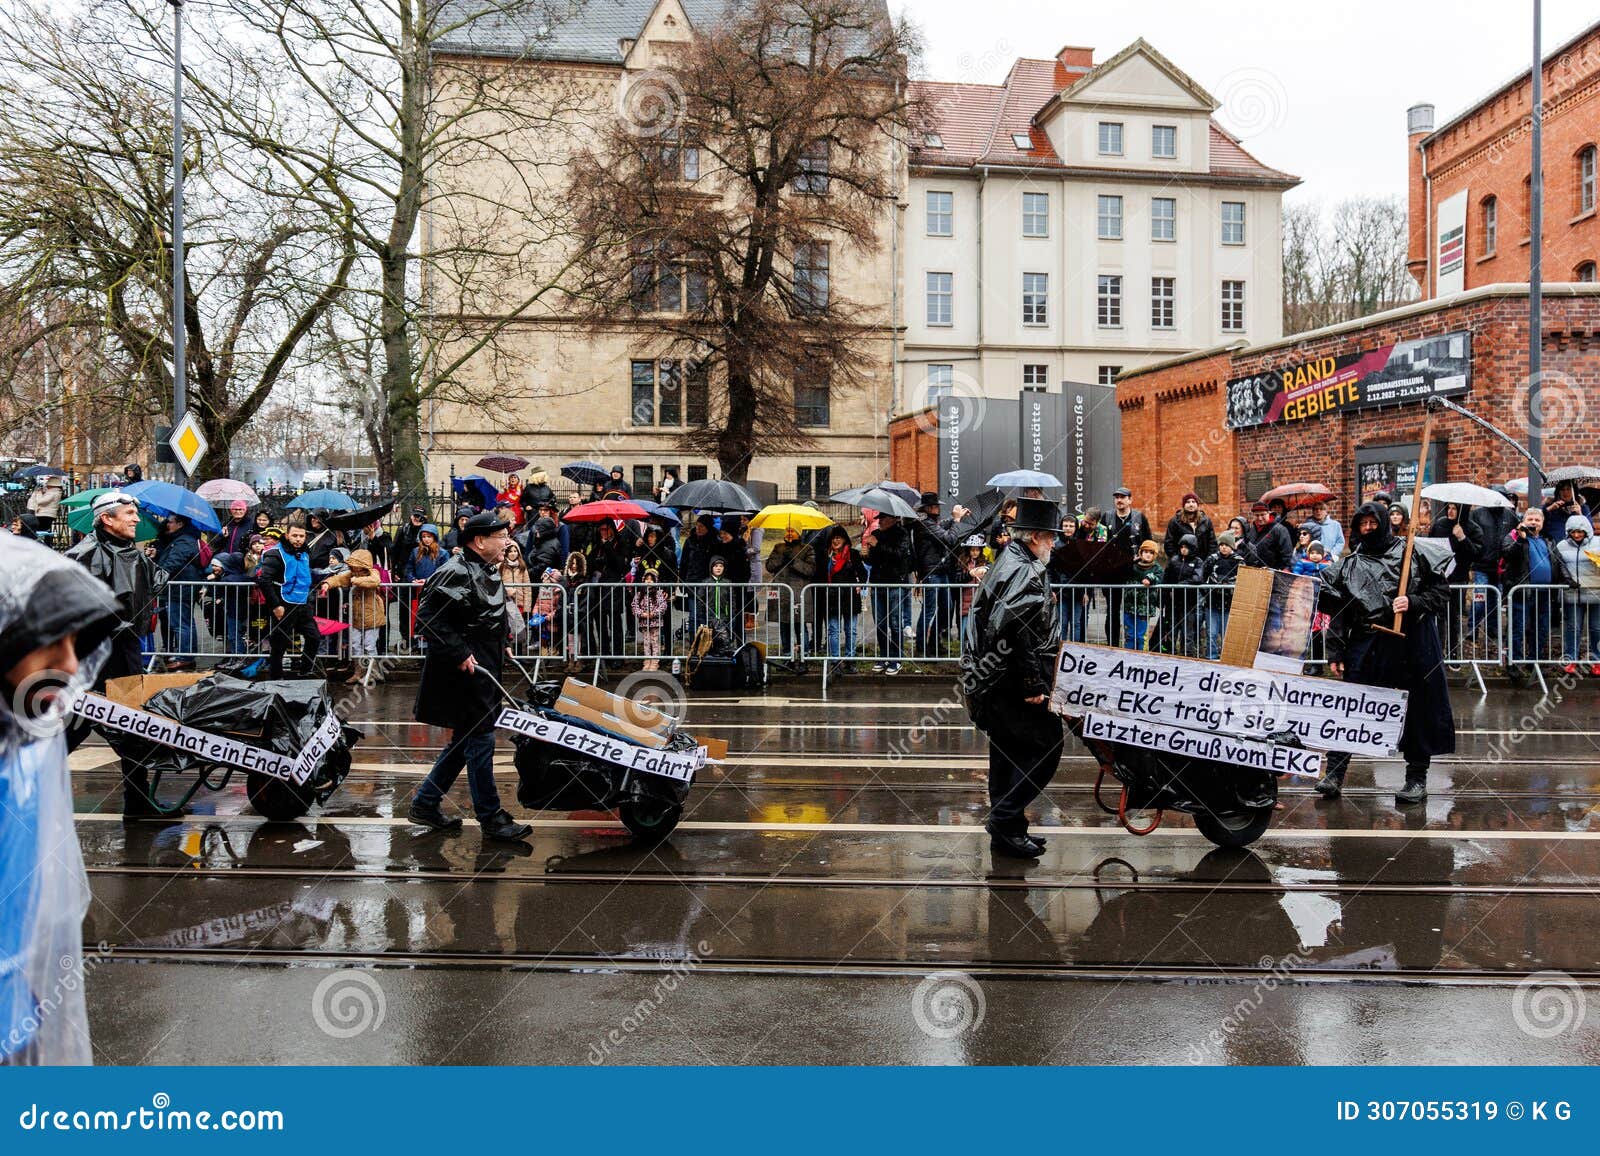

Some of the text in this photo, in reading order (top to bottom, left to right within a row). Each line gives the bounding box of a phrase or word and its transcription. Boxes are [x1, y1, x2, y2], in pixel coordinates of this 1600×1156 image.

[1283, 356, 1336, 394] RAND
[1284, 377, 1360, 420] GEBIETE
[1366, 376, 1424, 392] SONDERAUSSTELLUNG
[1400, 385, 1432, 397] 21.4.2024
[948, 405, 960, 497] Gedenkstätte
[1031, 402, 1043, 471] ngsstätte
[1074, 394, 1084, 514] Andreasstraße
[1059, 651, 1405, 722] Die Ampel, diese Narrenplage,
[1066, 685, 1391, 748] der EKC trägt sie zu Grabe.
[72, 695, 291, 779] das Leiden hat ein Ende
[294, 736, 327, 782] ruhet
[498, 710, 548, 736] Eure
[557, 724, 622, 761] letzte
[631, 749, 694, 780] Fahrt
[1085, 713, 1320, 775] letzter Gruß vom EKC
